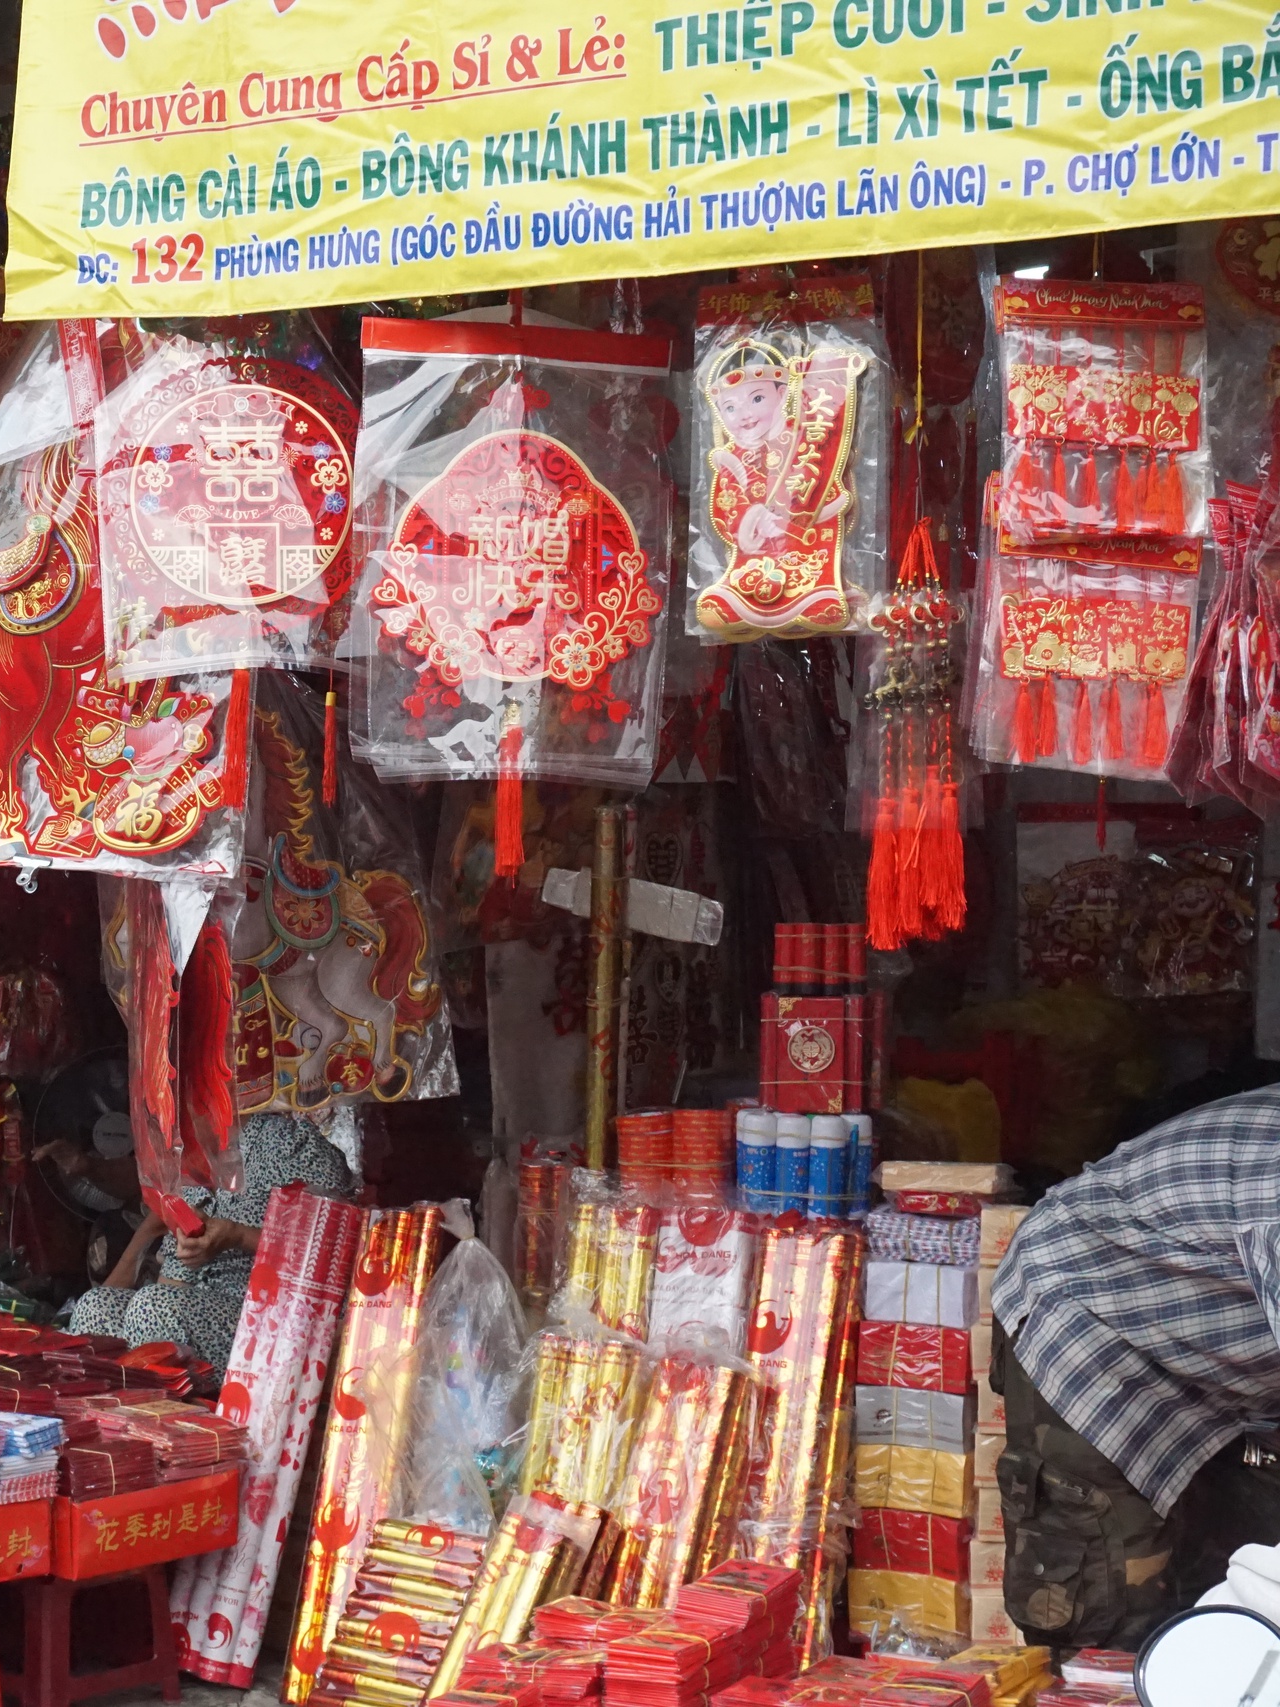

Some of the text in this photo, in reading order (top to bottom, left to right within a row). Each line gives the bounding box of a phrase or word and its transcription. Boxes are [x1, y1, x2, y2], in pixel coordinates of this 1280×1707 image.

[654, 0, 815, 71] THIỆP
[81, 15, 627, 141] Chuyên Cung Cấp Sỉ & Lẻ:
[80, 166, 186, 229] BÔNG
[198, 154, 257, 218] CÀI
[269, 146, 322, 212] ÁO
[361, 132, 470, 200] BÔNG
[483, 112, 627, 187] KHÁNH
[642, 94, 789, 171] THÀNH
[837, 76, 878, 147] LÌ
[894, 68, 939, 141] XÌ
[955, 48, 1048, 133] TẾT
[1100, 33, 1202, 118] ỐNG
[78, 253, 119, 284] ĐC:
[131, 233, 205, 284] 132
[214, 234, 300, 281] PHÙNG
[308, 226, 381, 270] HƯNG
[391, 215, 456, 266] (GÓC
[464, 201, 521, 254] ĐẦU
[531, 199, 633, 248] ĐƯỜNG
[644, 185, 691, 238] HẢI
[700, 181, 826, 232] THƯỢNG
[837, 168, 899, 218] LÃN
[909, 160, 987, 209] ÔNG)
[1023, 159, 1054, 196] P.
[1067, 143, 1139, 197] CHỢ
[1150, 131, 1220, 185] LỚN
[784, 387, 835, 506] 大吉大利
[223, 508, 261, 521] LOVE
[467, 510, 571, 562] 新婚
[452, 562, 580, 611] 快乐
[115, 779, 164, 839] 福
[202, 780, 218, 797] 吉
[701, 1249, 731, 1259] DANG
[366, 1300, 392, 1309] DANG
[759, 1359, 788, 1369] DANG
[96, 1497, 223, 1553] 花季利是封
